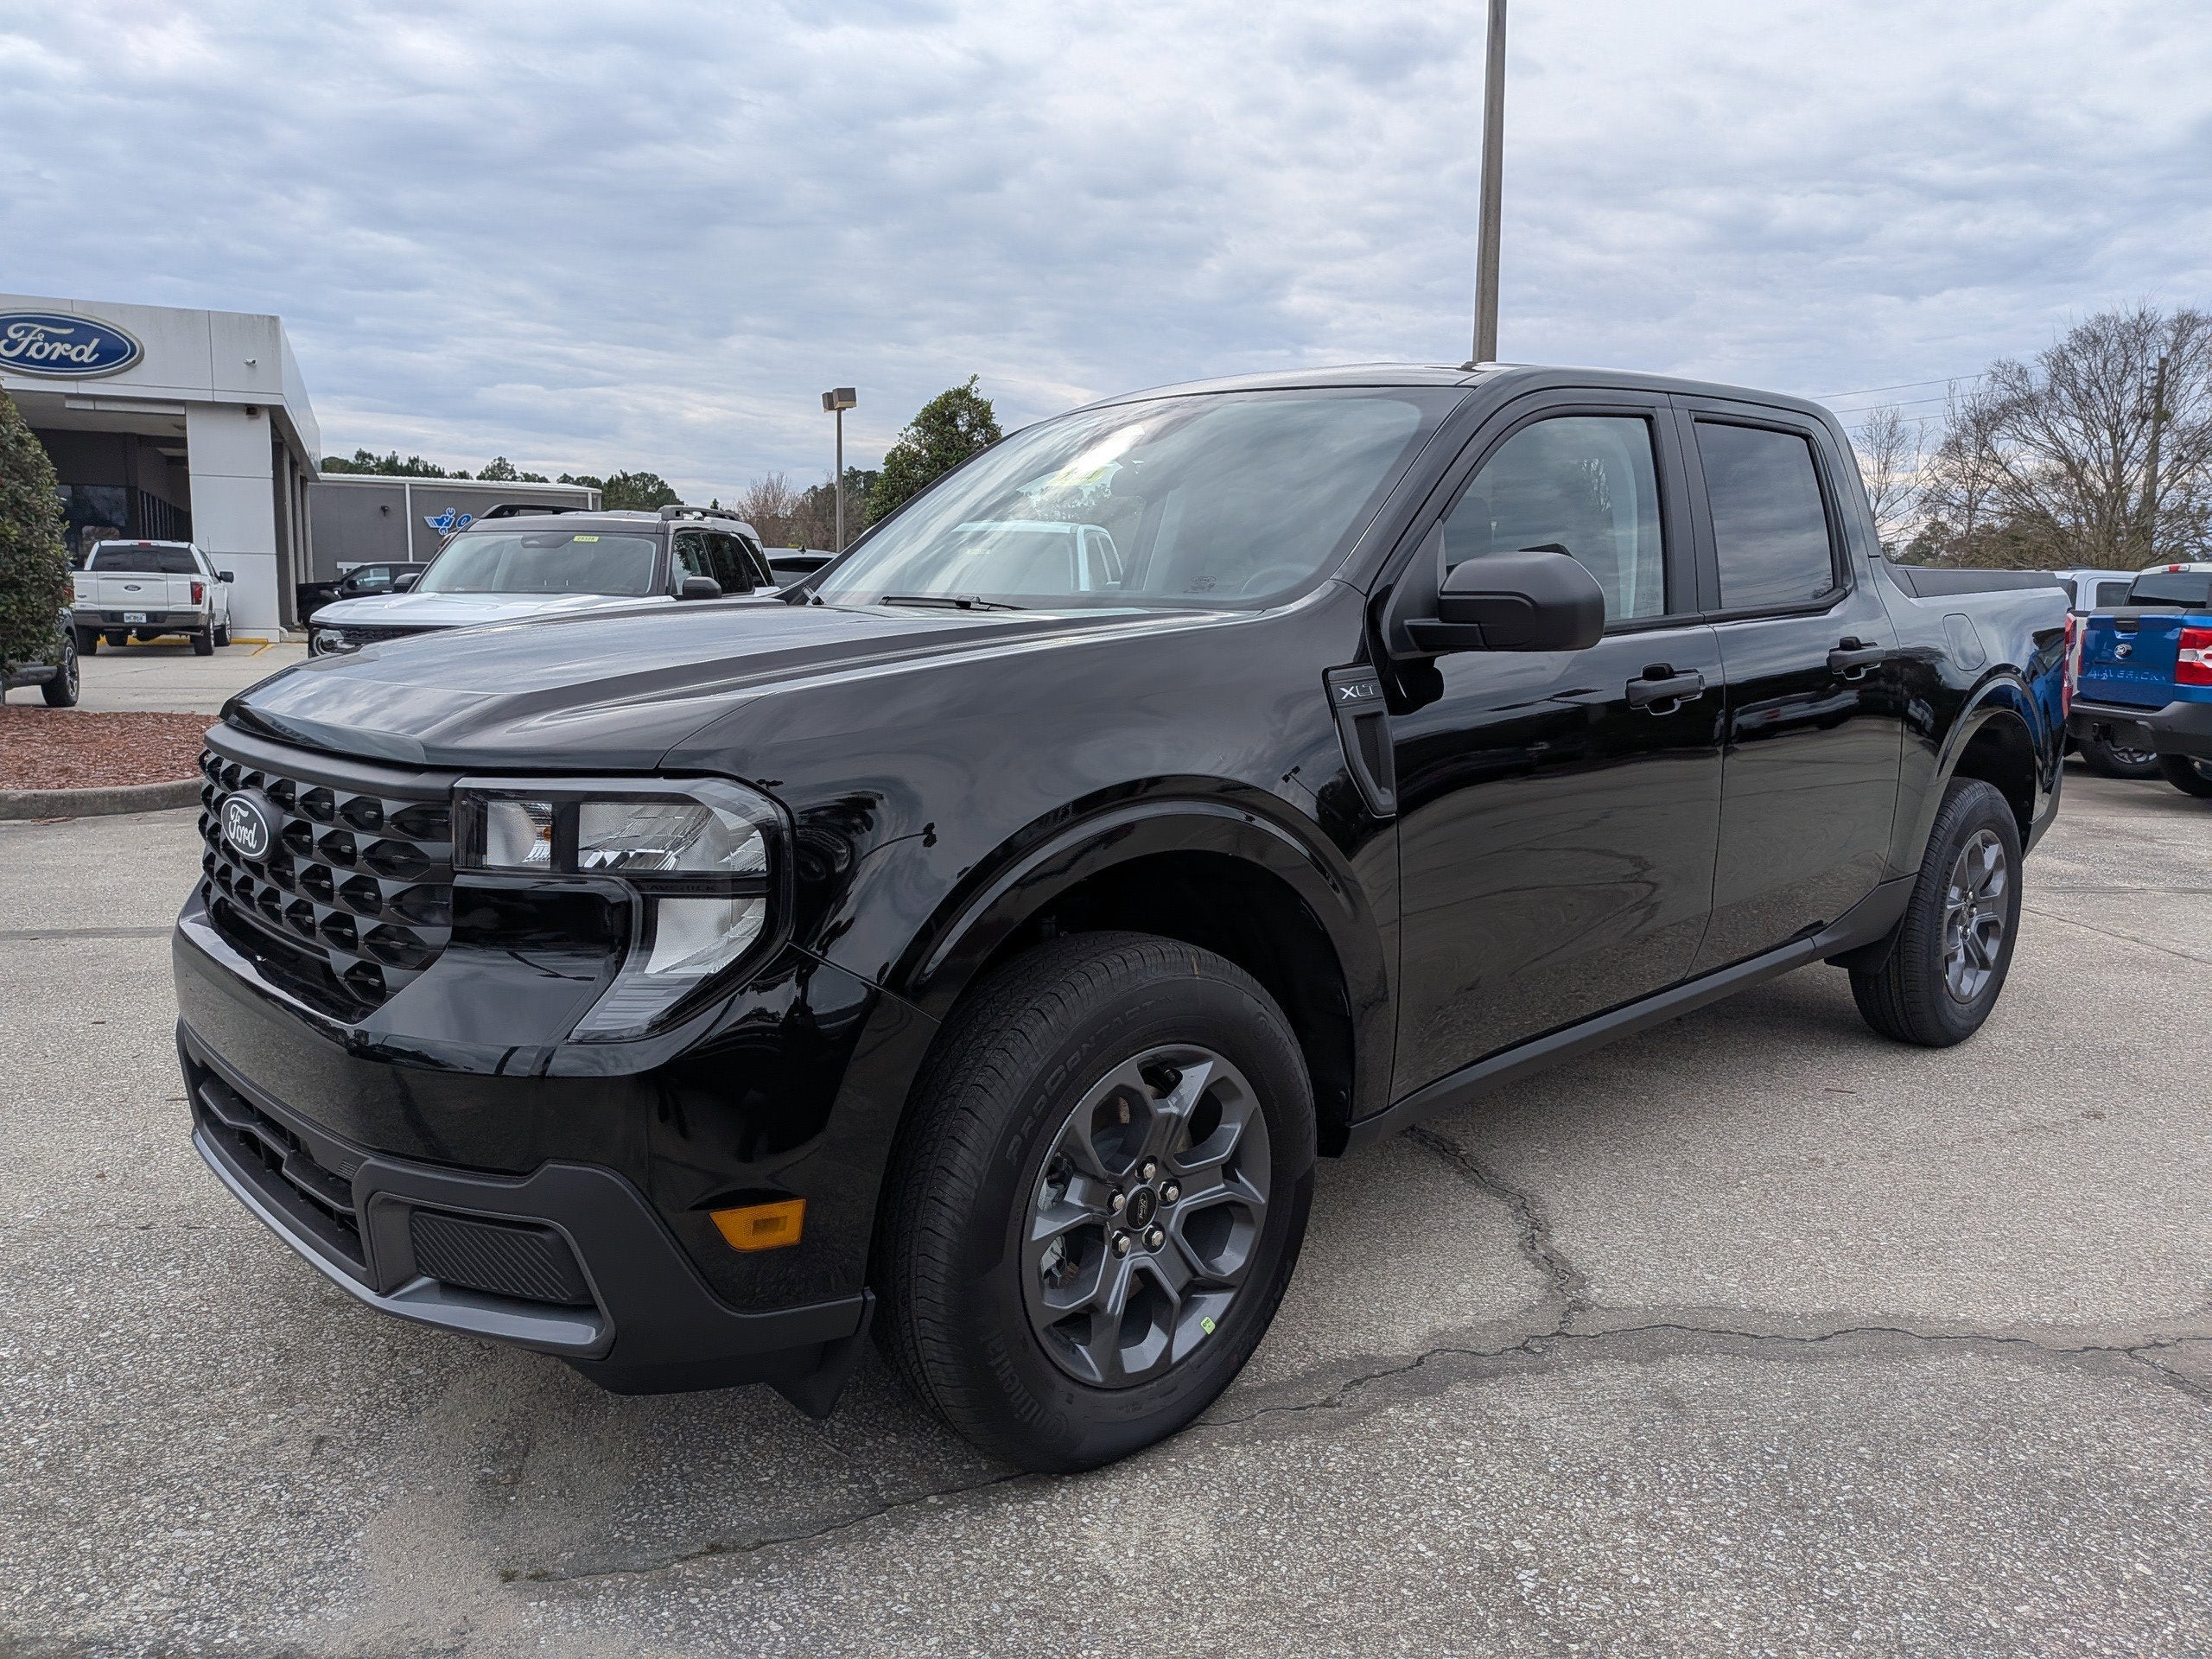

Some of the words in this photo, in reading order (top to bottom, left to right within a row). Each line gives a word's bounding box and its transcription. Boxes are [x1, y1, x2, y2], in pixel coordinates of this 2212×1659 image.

[0, 322, 100, 363] Ford
[1339, 683, 1379, 700] XLT
[228, 804, 257, 849] Ford
